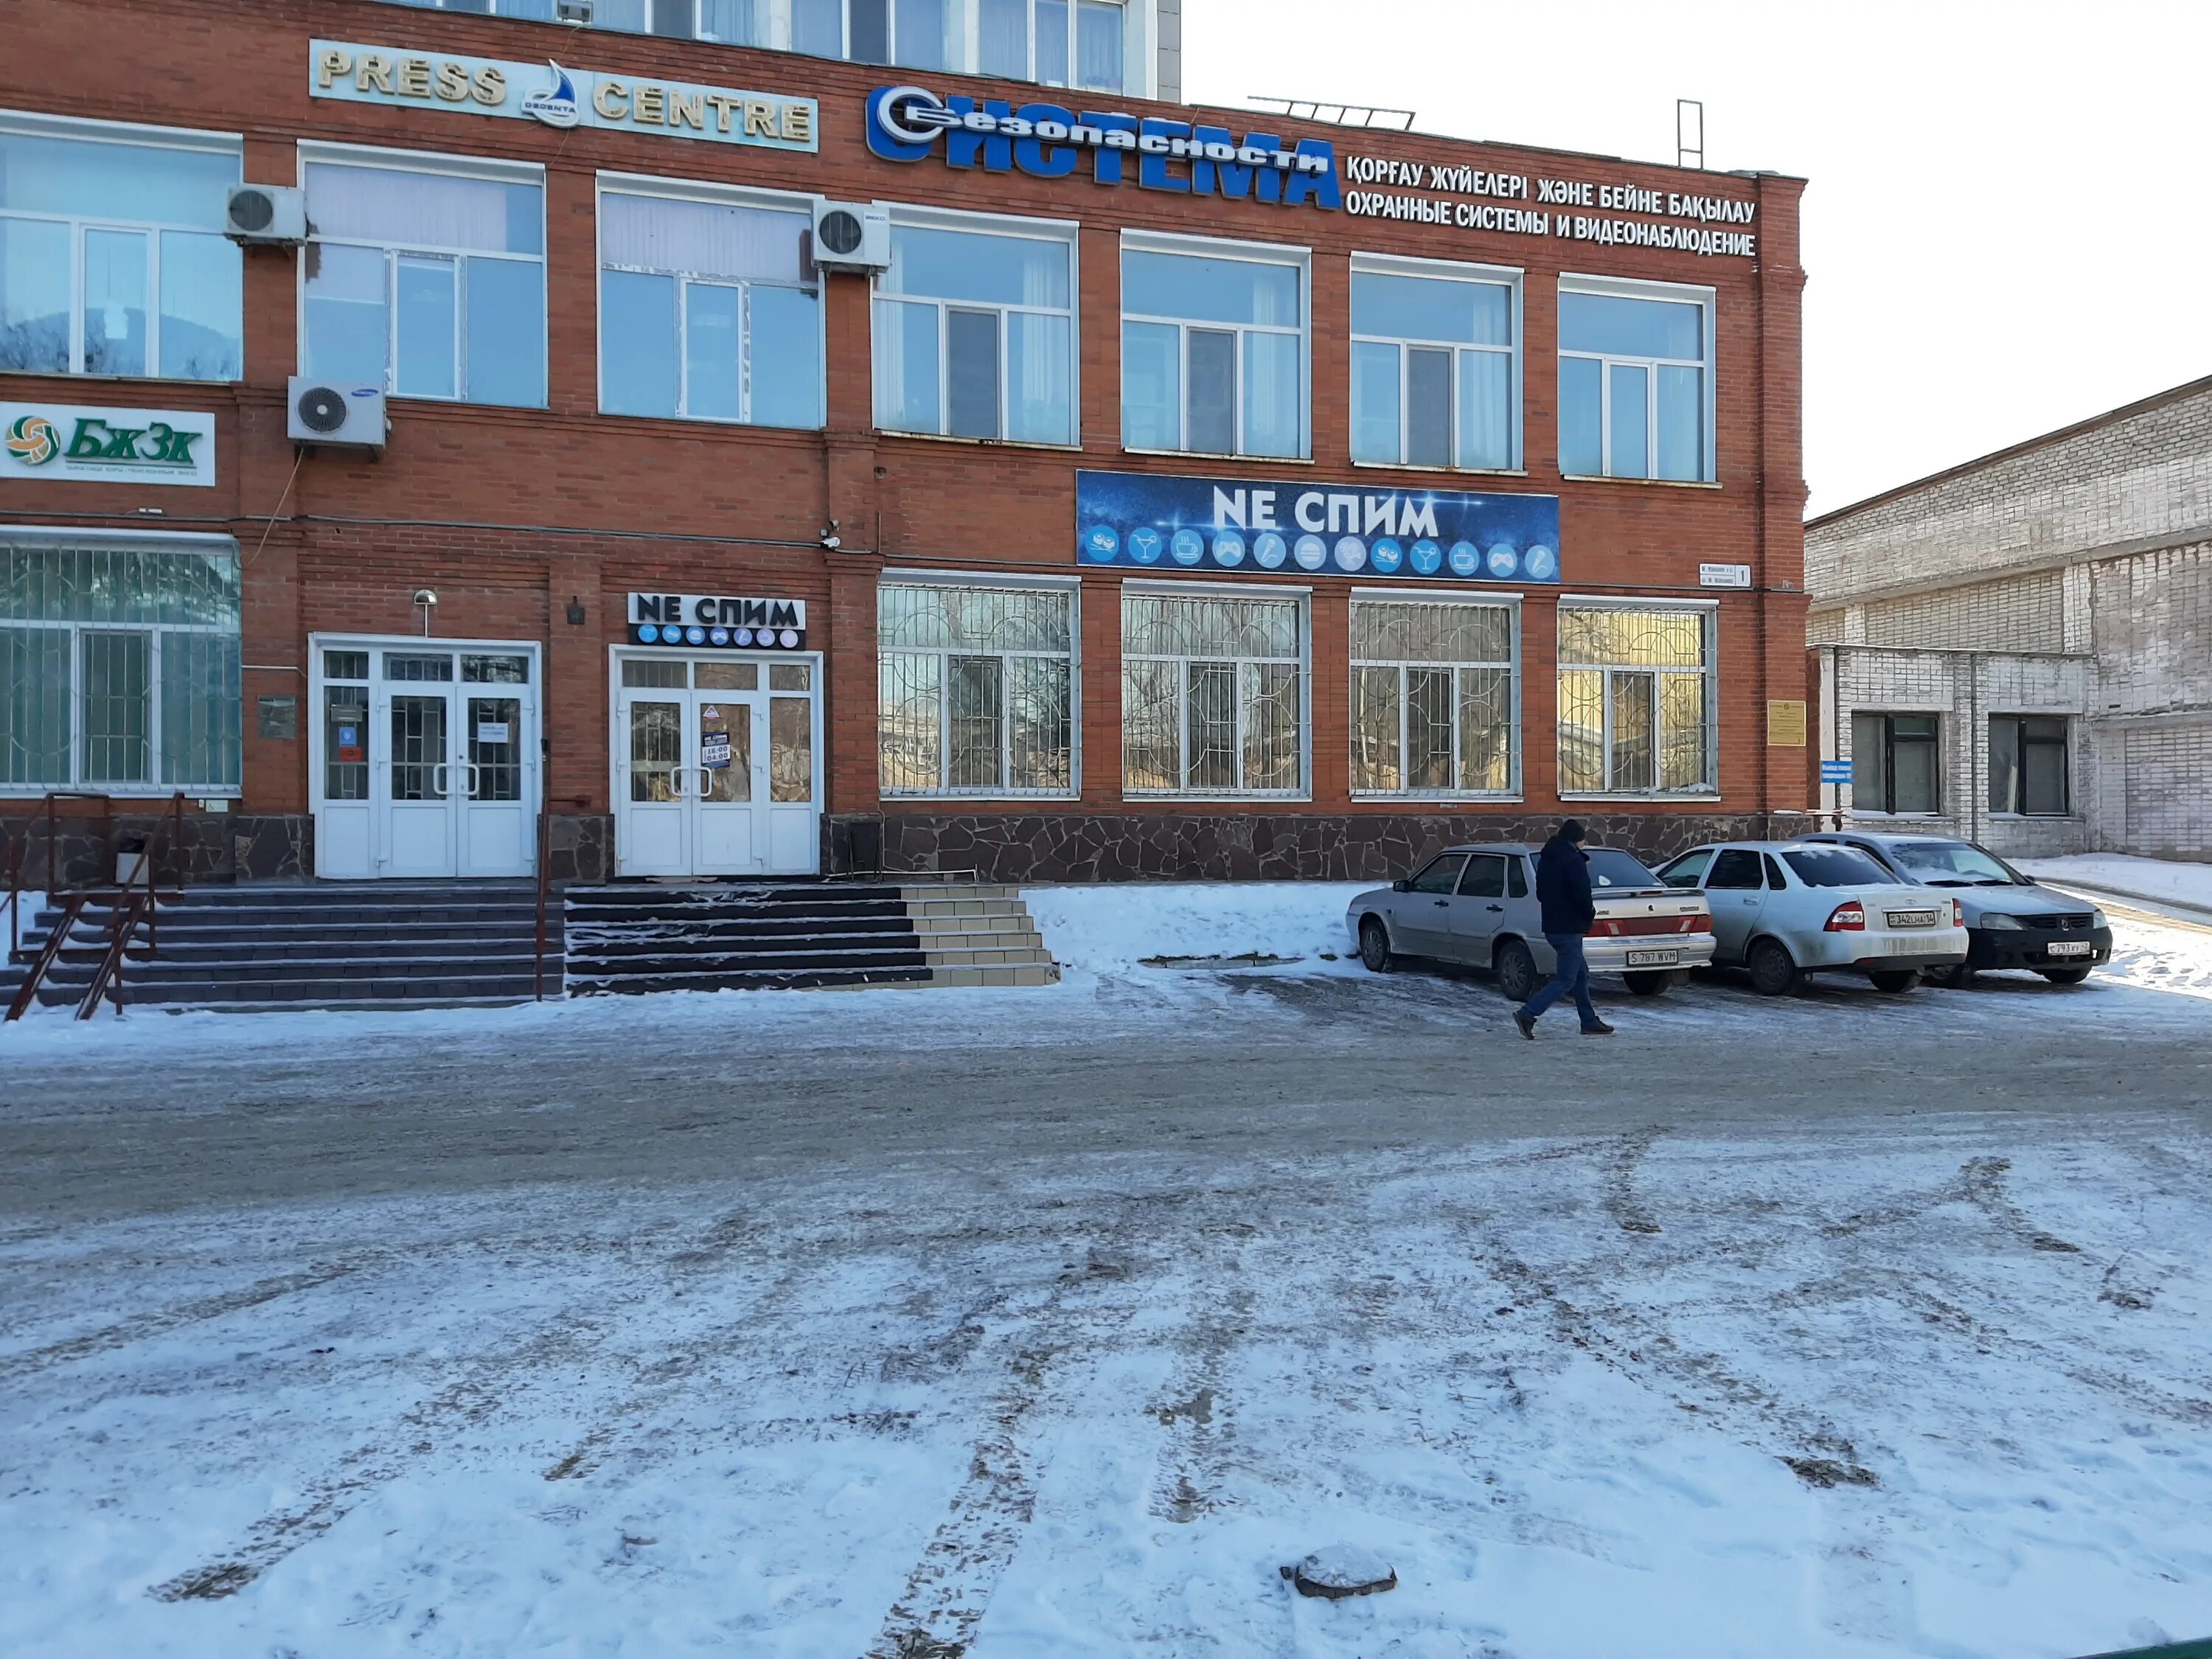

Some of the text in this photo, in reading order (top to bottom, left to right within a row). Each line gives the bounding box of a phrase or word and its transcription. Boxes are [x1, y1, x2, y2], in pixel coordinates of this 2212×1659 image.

[317, 49, 812, 142] PRESS CENTRE
[1346, 155, 1756, 223] ҚОРҒАУ ЖҮЙЕЛЕРІ ЖӘНЕ БЕЙНЕ БАҚЫЛАУ
[1345, 190, 1756, 257] ОХРАННЫЕ СИСТЕМЫ И ВИДЕОНАБЛЮДЕНИЕ
[1213, 484, 1439, 538] NE СПИМ
[1741, 570, 1745, 582] 1
[637, 593, 799, 627] NE СПИМ
[1631, 953, 1637, 963] S
